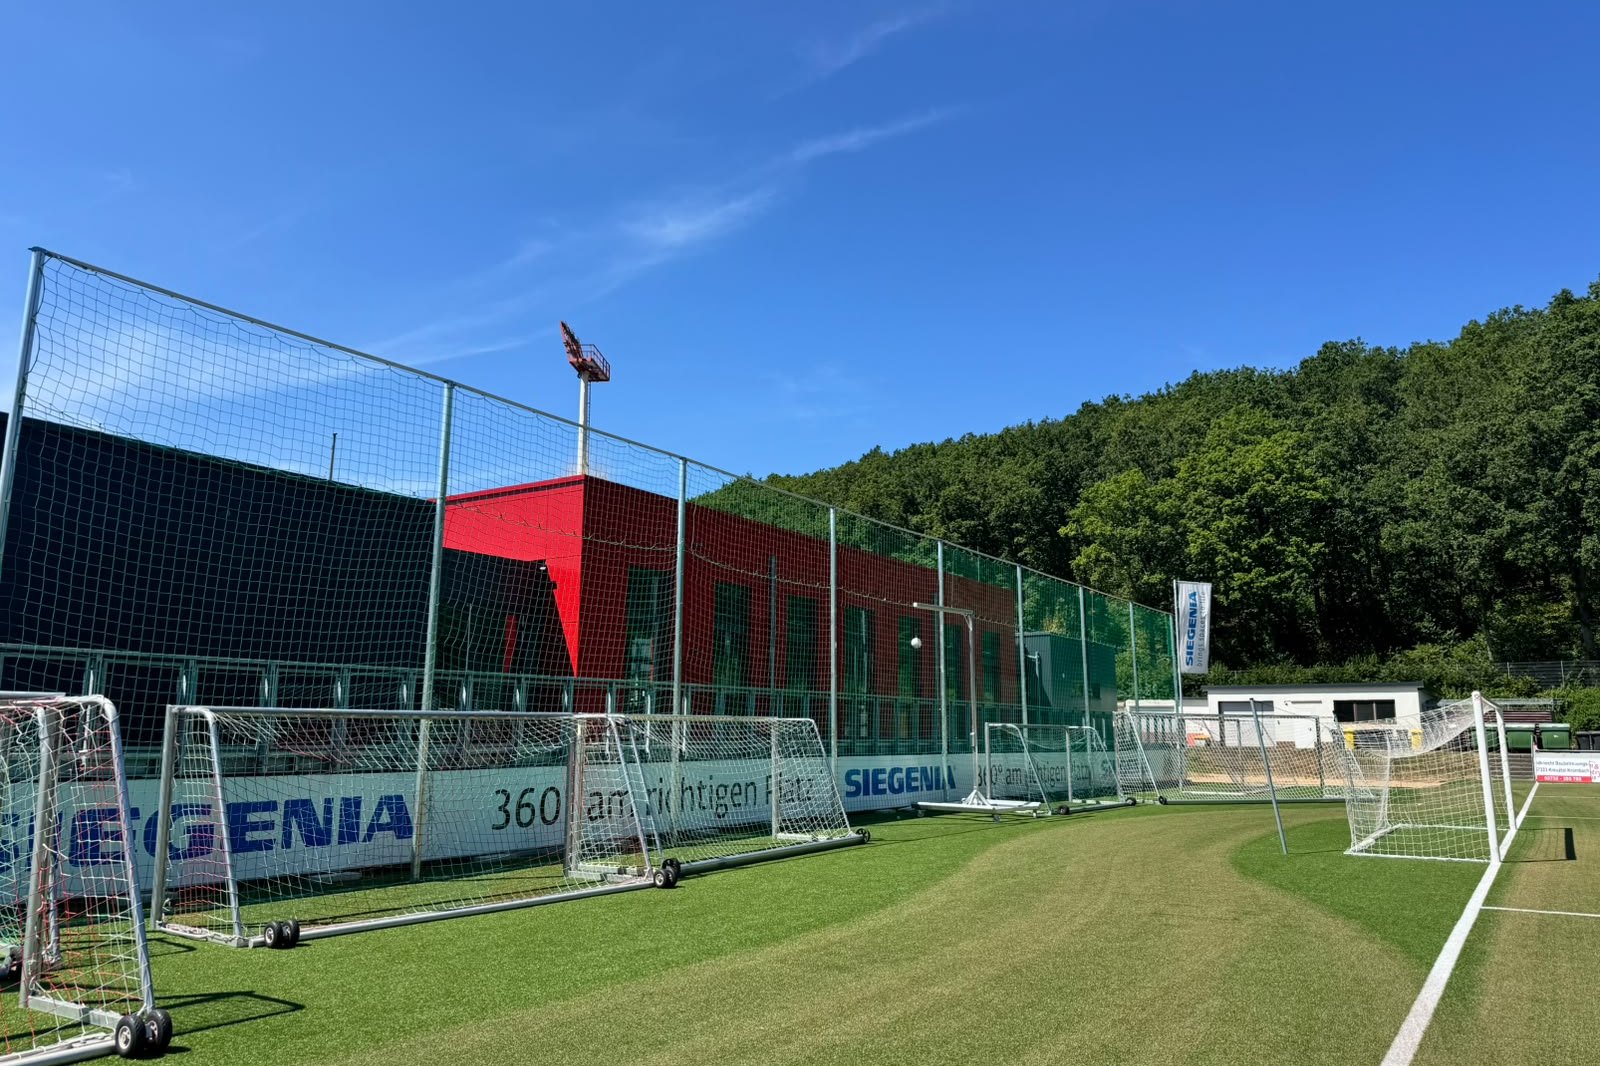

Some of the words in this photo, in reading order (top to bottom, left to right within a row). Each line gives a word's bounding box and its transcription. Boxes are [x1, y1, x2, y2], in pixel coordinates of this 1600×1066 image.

[1185, 591, 1198, 667] SIEGENIA
[845, 765, 956, 798] SIEGENIA
[1006, 767, 1022, 785] am
